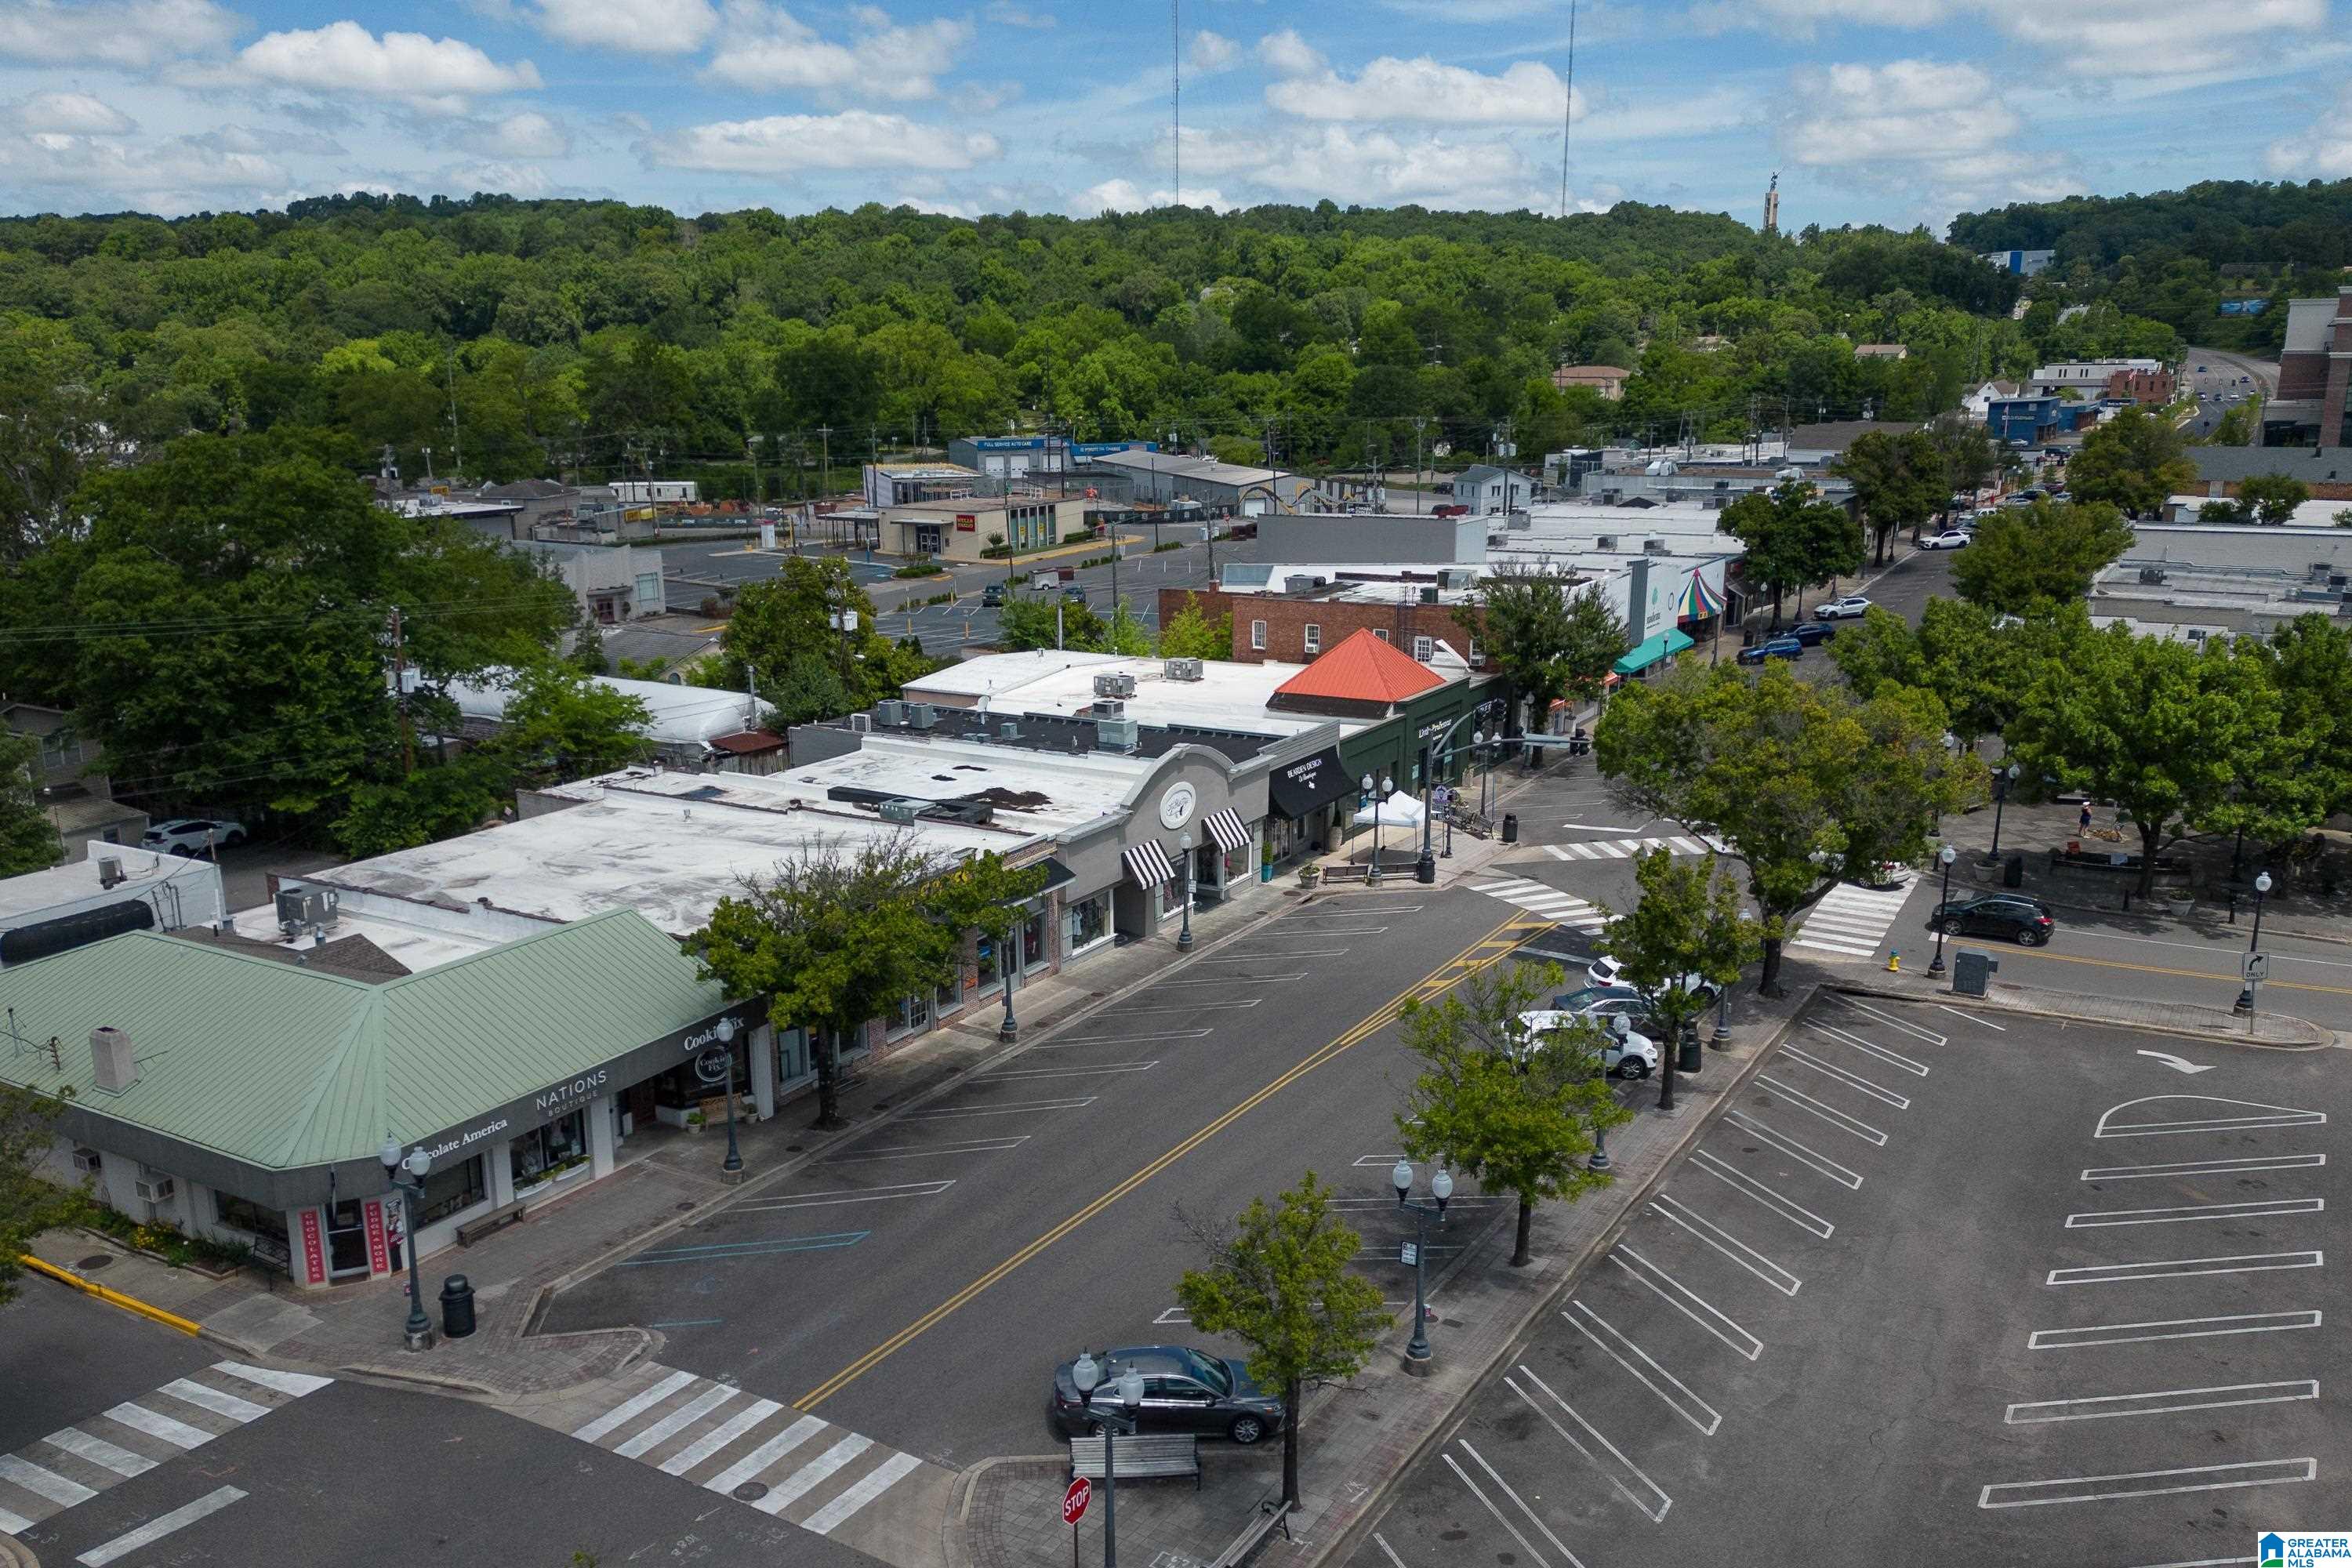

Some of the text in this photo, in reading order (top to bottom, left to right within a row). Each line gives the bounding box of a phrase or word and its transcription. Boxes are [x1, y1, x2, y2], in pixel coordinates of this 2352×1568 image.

[1287, 759, 1323, 779] BEARDEN DESIGN
[684, 1025, 718, 1051] Cooki
[535, 1070, 607, 1111] NATIONS
[548, 1090, 598, 1117] BOUTIQUE
[401, 1119, 508, 1170] Ccolate America
[305, 1213, 321, 1279] CHOCOLATES
[1065, 1486, 1089, 1516] STOP
